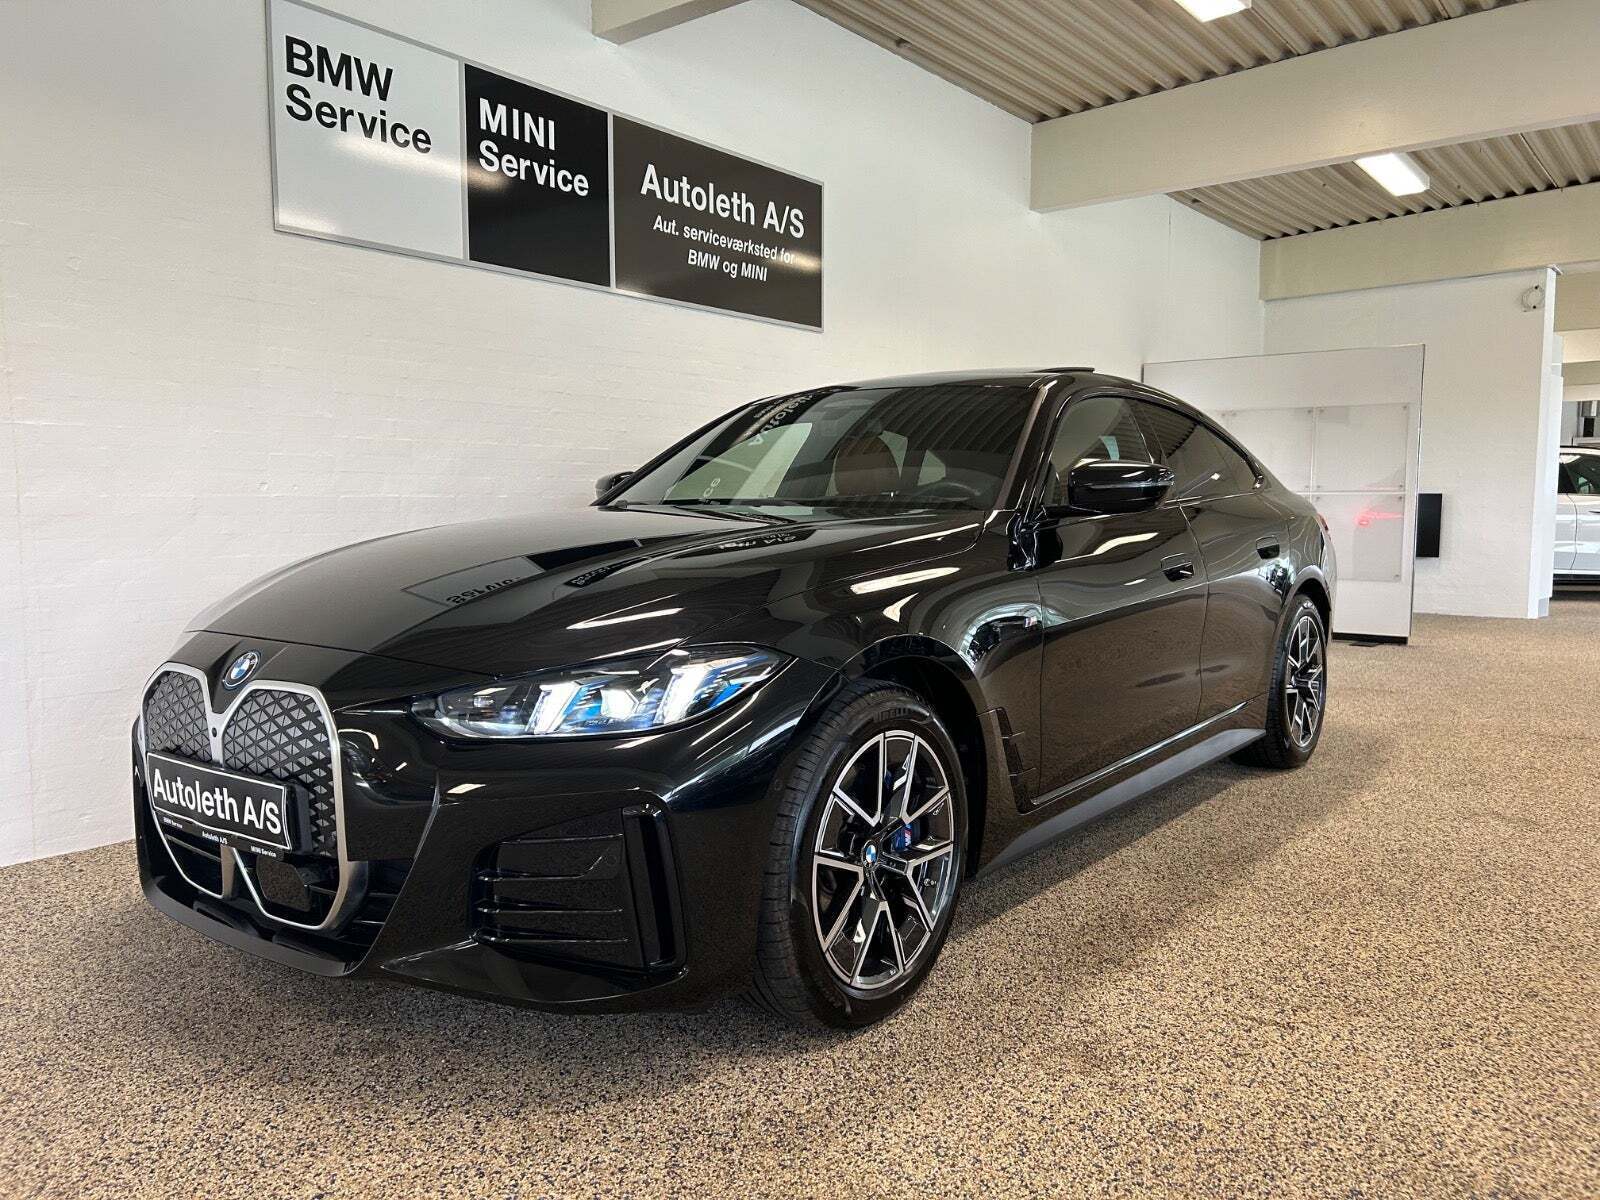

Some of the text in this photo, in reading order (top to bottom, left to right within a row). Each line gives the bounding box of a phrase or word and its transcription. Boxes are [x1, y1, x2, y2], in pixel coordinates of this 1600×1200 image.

[285, 34, 393, 102] BMW
[285, 83, 432, 154] Service
[480, 97, 555, 151] MINI
[479, 140, 589, 196] Service
[640, 163, 805, 239] Autoleth A/S
[652, 215, 796, 264] Aut. serviceværksted for
[687, 249, 768, 282] BMW og MINI
[153, 768, 281, 834] Autoleth A/S
